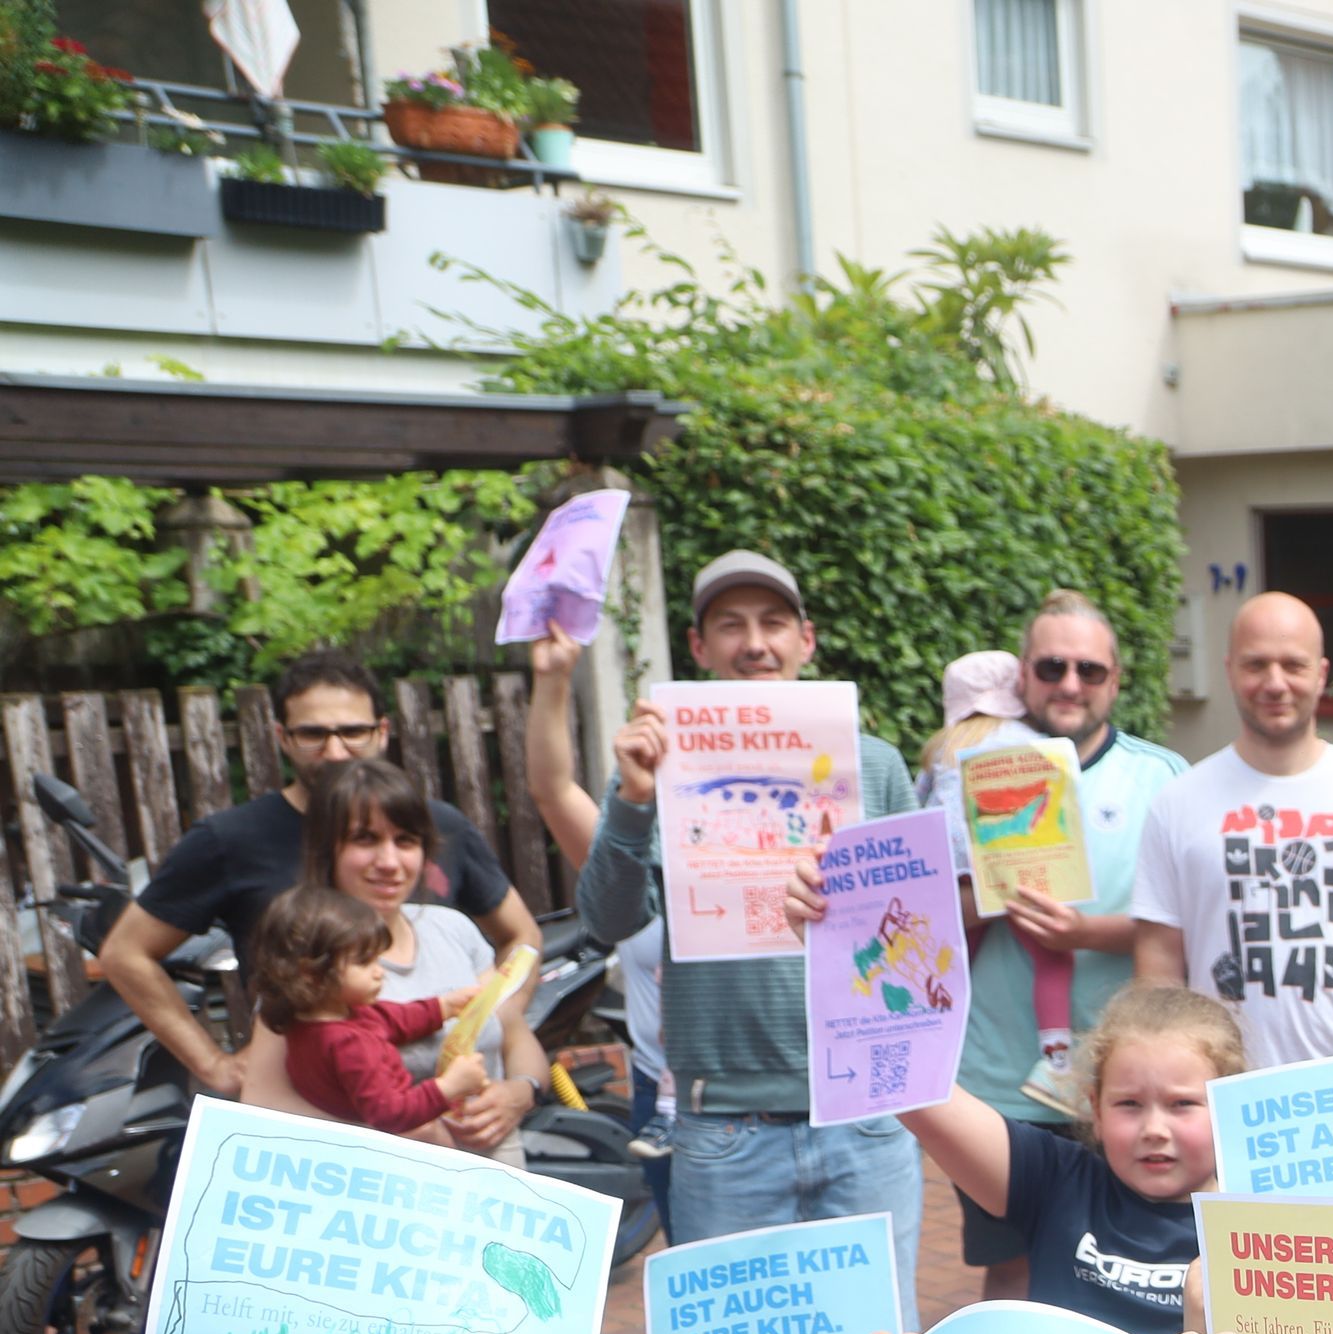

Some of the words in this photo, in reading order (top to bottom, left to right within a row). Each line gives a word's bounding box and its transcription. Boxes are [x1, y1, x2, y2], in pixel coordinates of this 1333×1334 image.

[676, 706, 729, 726] DAT
[737, 706, 771, 724] ES
[678, 732, 734, 751] UNS
[742, 731, 813, 750] KITA.
[854, 838, 911, 862] PÄNZ,
[821, 872, 855, 895] UNS
[858, 858, 938, 886] VEEDEL.
[1246, 1128, 1300, 1161] IST
[232, 1146, 450, 1217] UNSERE
[463, 1192, 574, 1252] KITA
[221, 1192, 311, 1235] IST
[320, 1210, 476, 1266] AUCH
[211, 1237, 364, 1290] EURE
[668, 1253, 789, 1298] UNSERE
[797, 1243, 869, 1274] KITA
[1075, 1232, 1190, 1288] EURO
[671, 1298, 715, 1330] IST
[724, 1282, 814, 1317] AUCH
[1236, 1314, 1259, 1334] Seit
